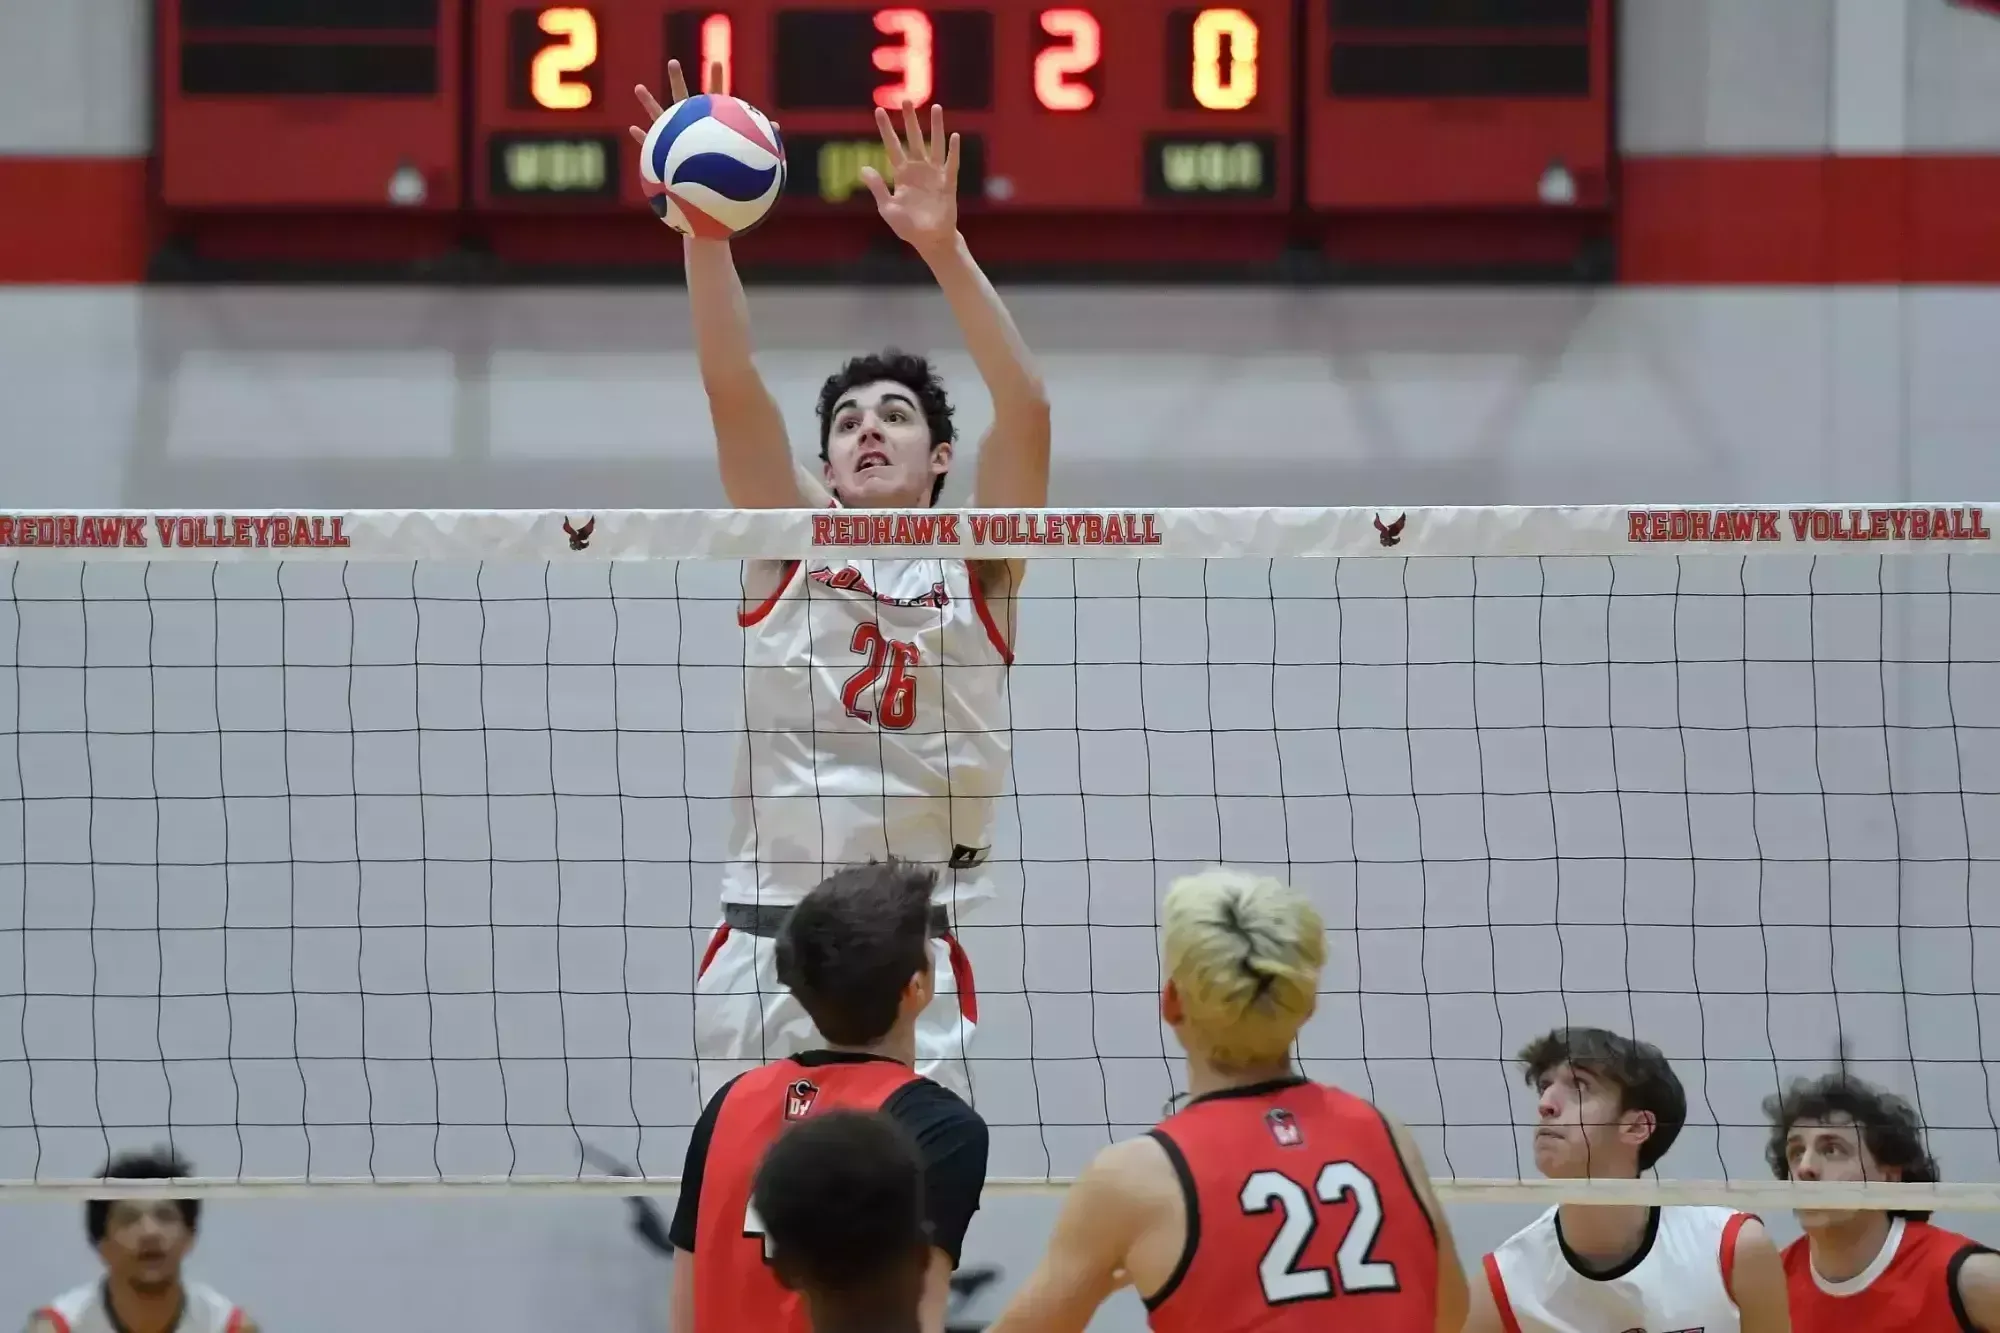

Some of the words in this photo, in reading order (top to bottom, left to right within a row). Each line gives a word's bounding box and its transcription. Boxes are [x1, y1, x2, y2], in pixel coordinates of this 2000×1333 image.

[531, 7, 597, 109] 2
[701, 13, 732, 95] 1
[871, 8, 933, 110] 3
[1033, 8, 1101, 111] 2
[1191, 8, 1258, 110] 0
[0, 516, 147, 547] REDHAWK
[155, 516, 350, 547] VOLLEYBALL
[812, 514, 960, 546] REDHAWK
[968, 514, 1162, 545] VOLLEYBALL
[1627, 510, 1781, 541] REDHAWK
[1789, 508, 1991, 540] VOLLEYBALL
[840, 622, 920, 730] 26
[1239, 1160, 1400, 1307] 22
